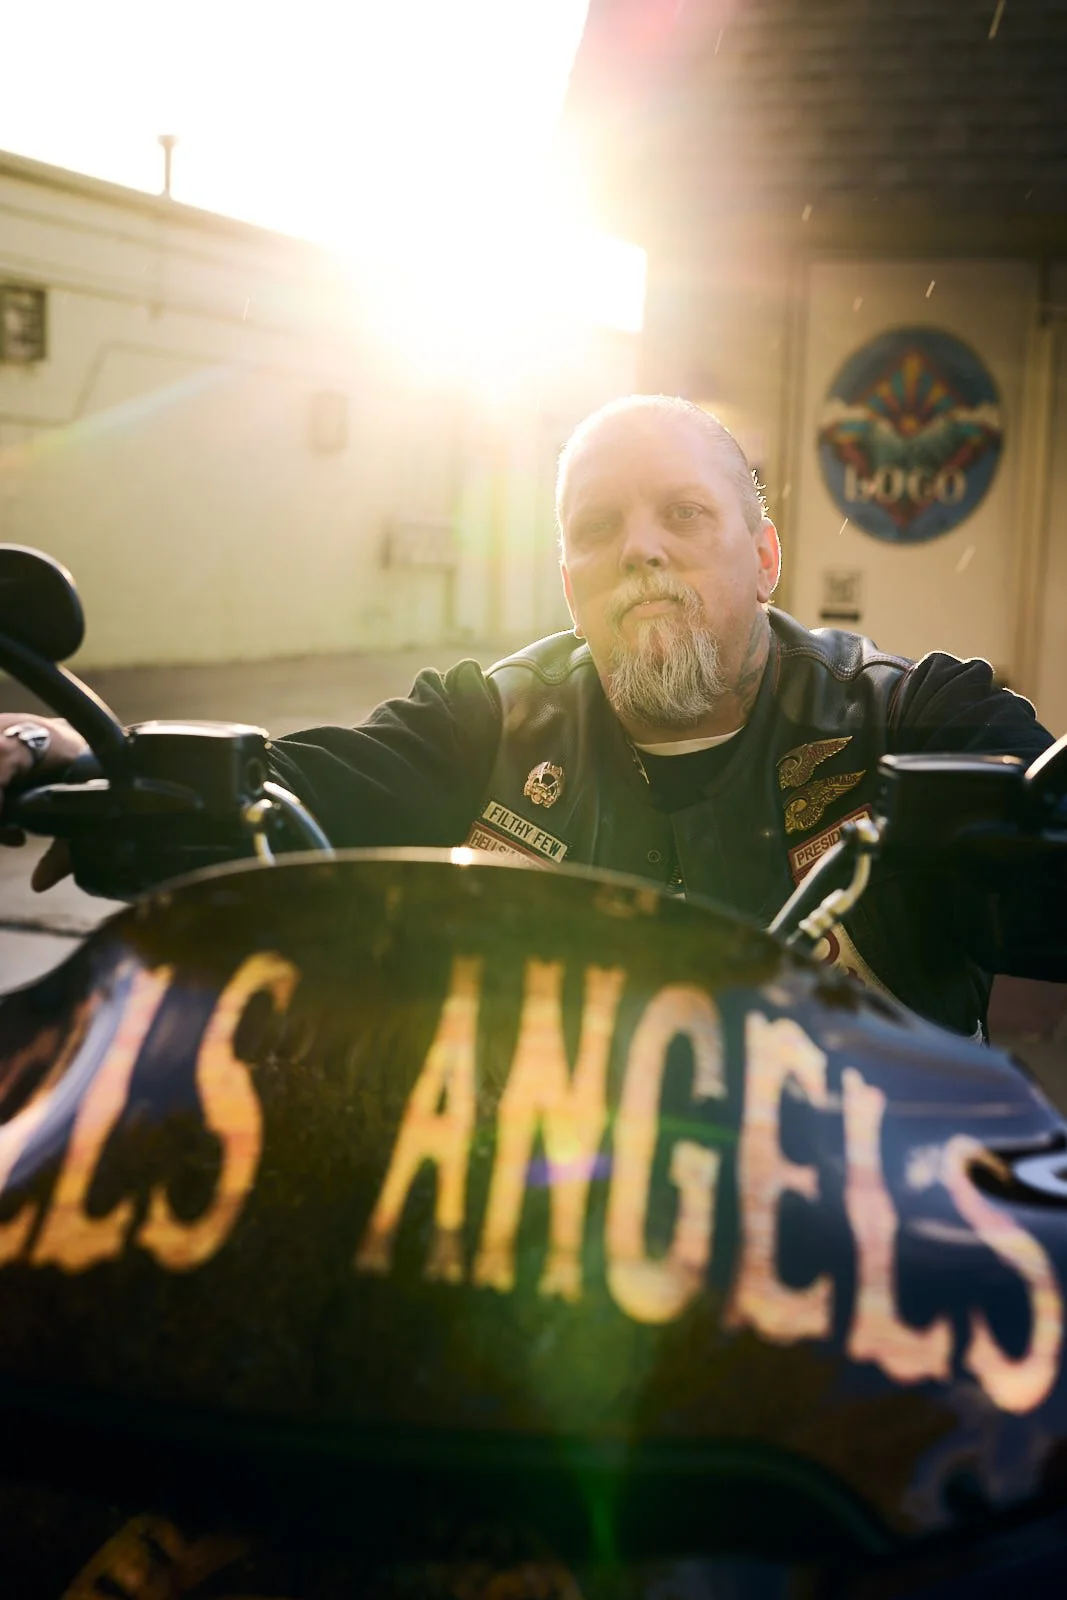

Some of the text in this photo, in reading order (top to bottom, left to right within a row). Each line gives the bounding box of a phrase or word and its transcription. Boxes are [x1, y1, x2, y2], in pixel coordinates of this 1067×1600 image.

[490, 807, 561, 857] FILTHY FEW
[796, 814, 866, 866] PRESID
[355, 955, 1062, 1413] ANGELS
